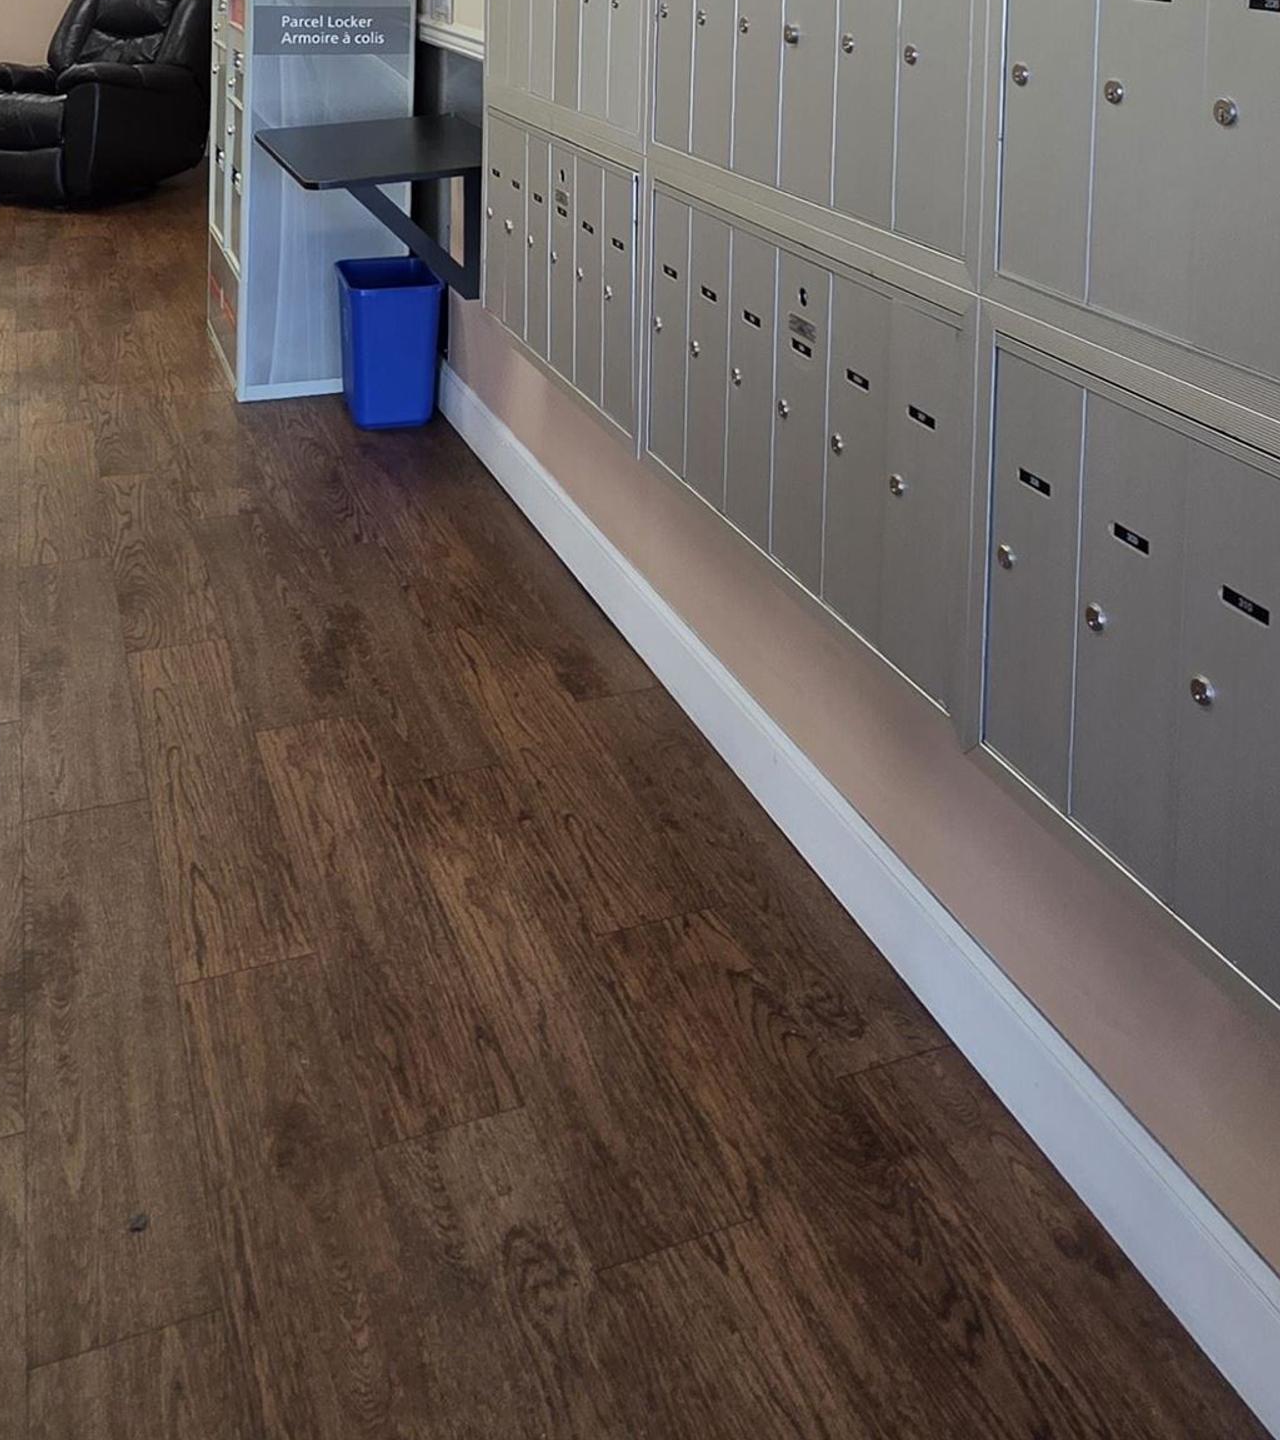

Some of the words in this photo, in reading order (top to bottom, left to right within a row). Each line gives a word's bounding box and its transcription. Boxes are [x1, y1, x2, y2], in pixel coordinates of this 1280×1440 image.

[281, 15, 324, 28] Parcel
[327, 15, 373, 28] Locker
[281, 31, 340, 44] Armoire
[342, 31, 351, 44] à
[354, 31, 385, 44] colis
